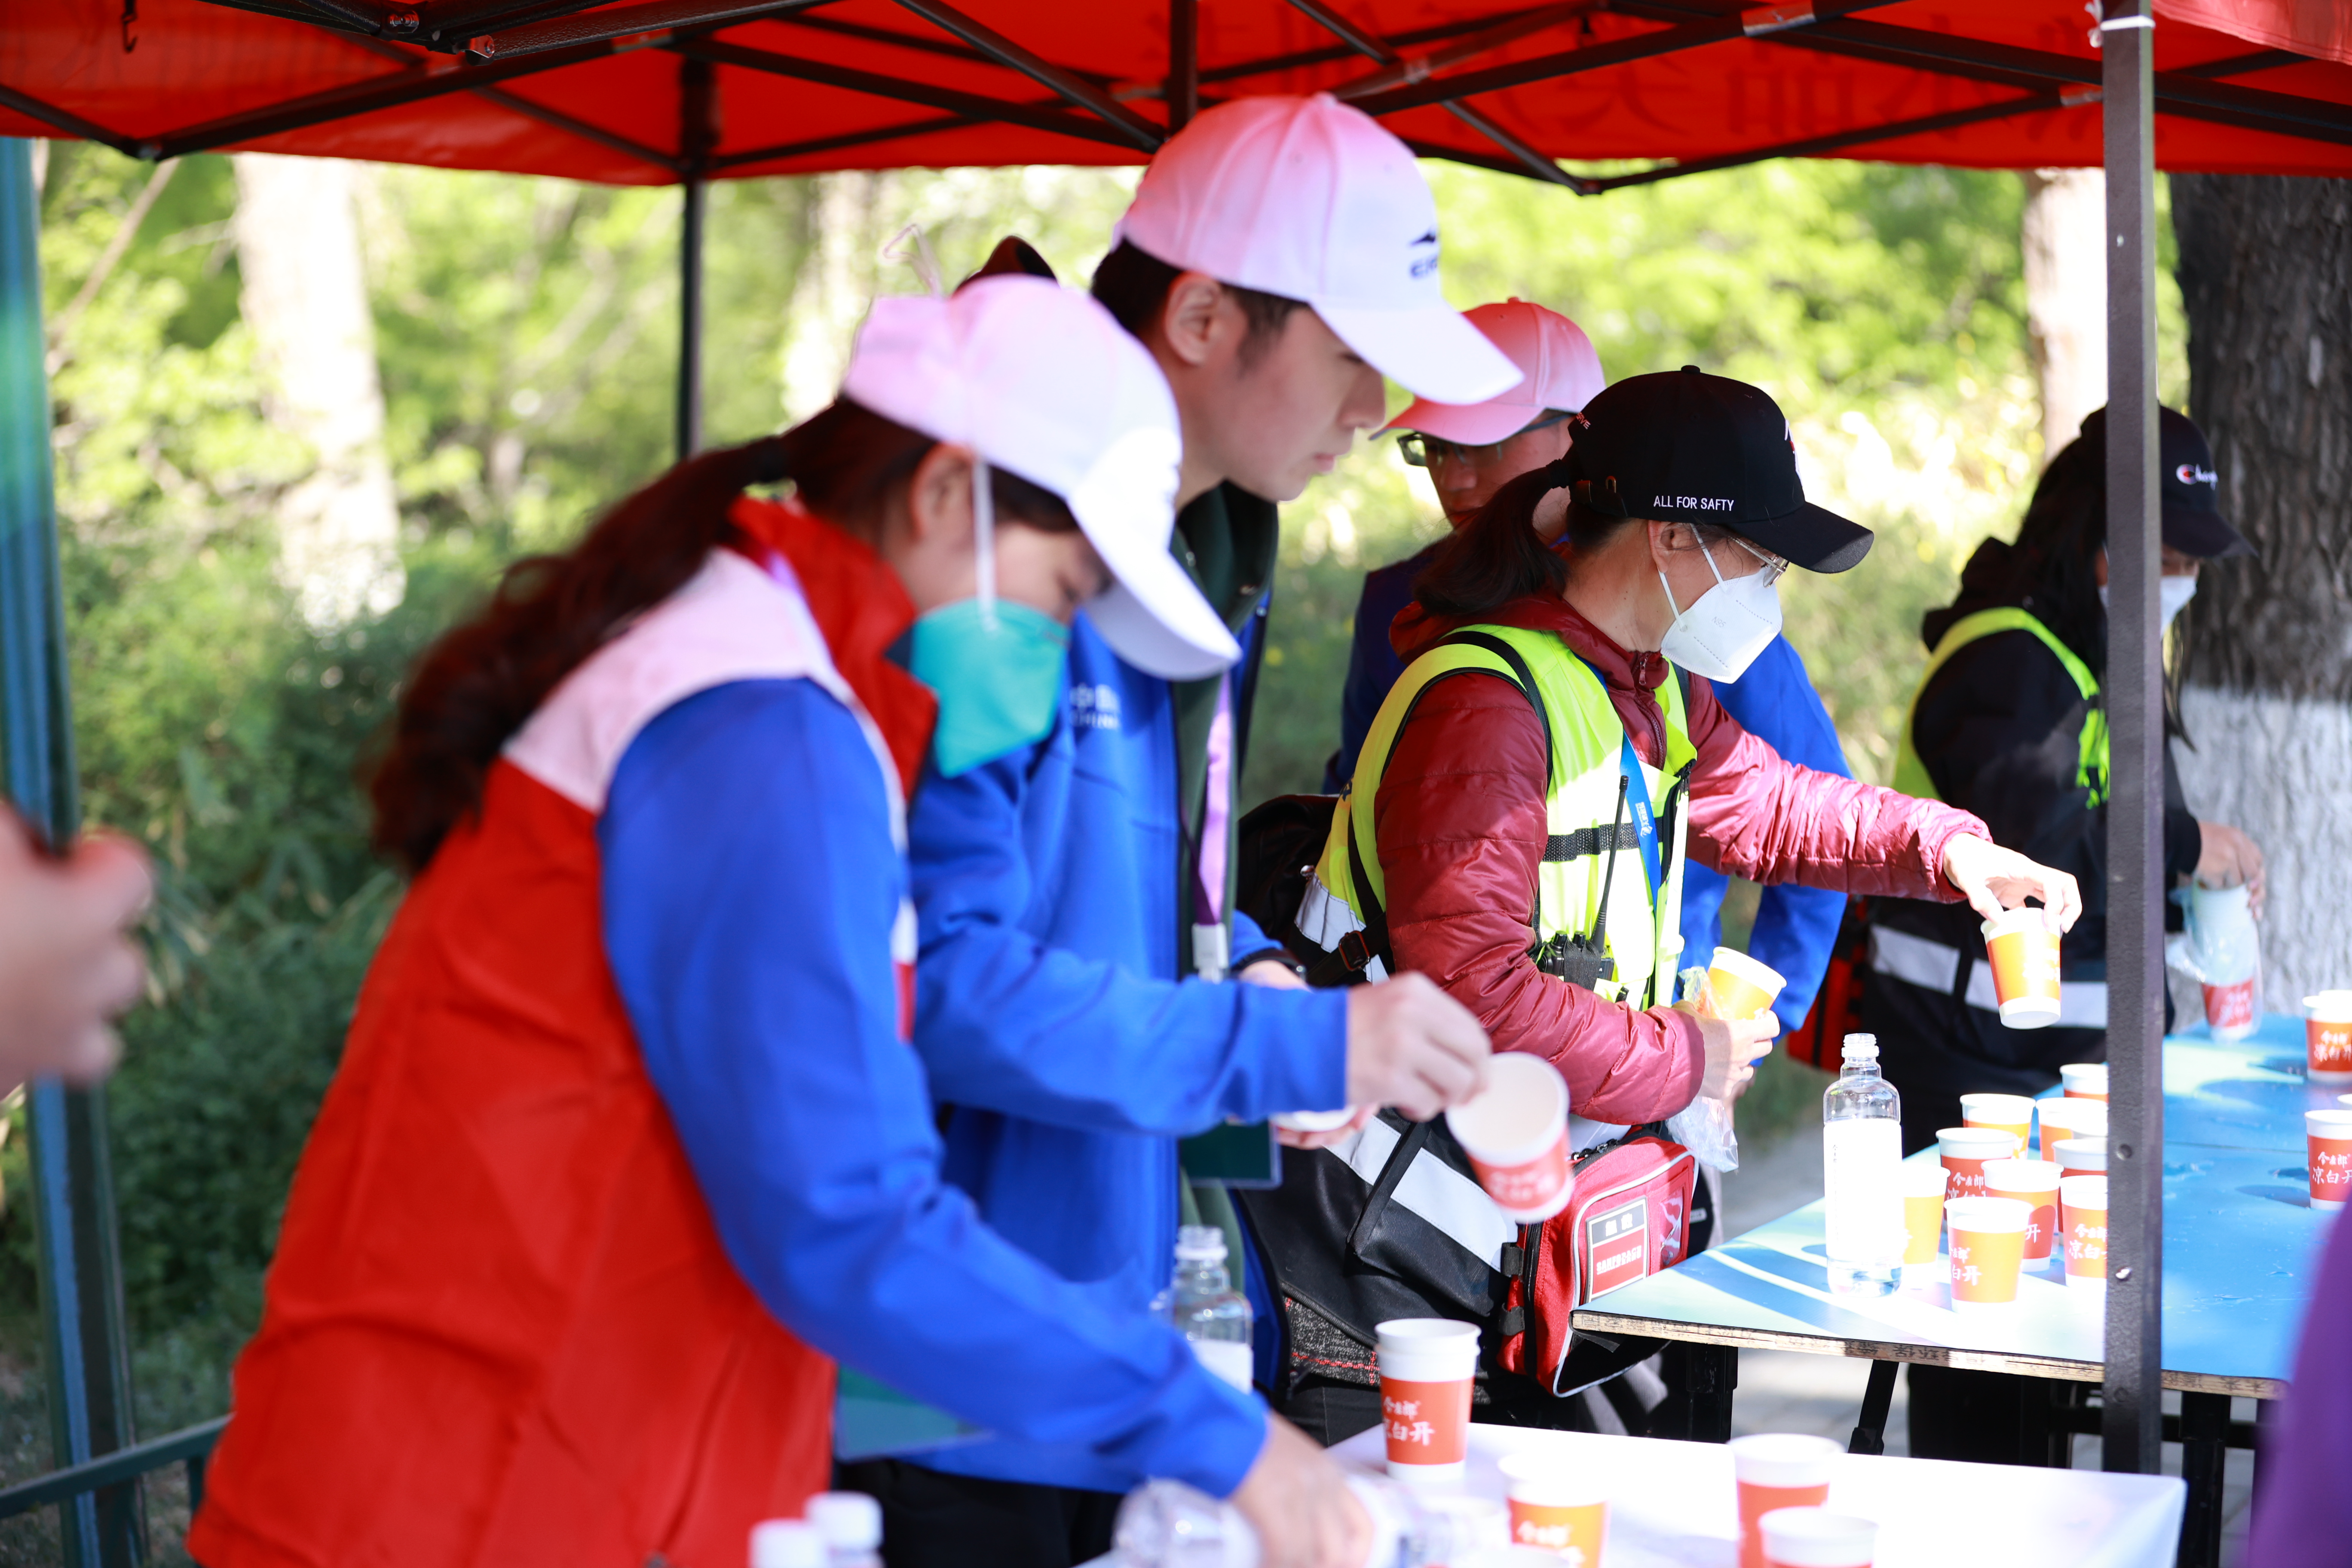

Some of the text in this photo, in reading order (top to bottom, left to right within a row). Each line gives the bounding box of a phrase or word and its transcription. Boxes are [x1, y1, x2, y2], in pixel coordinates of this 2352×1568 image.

[1654, 496, 1734, 511] ALL FOR SAFTY
[1711, 616, 1726, 628] N95
